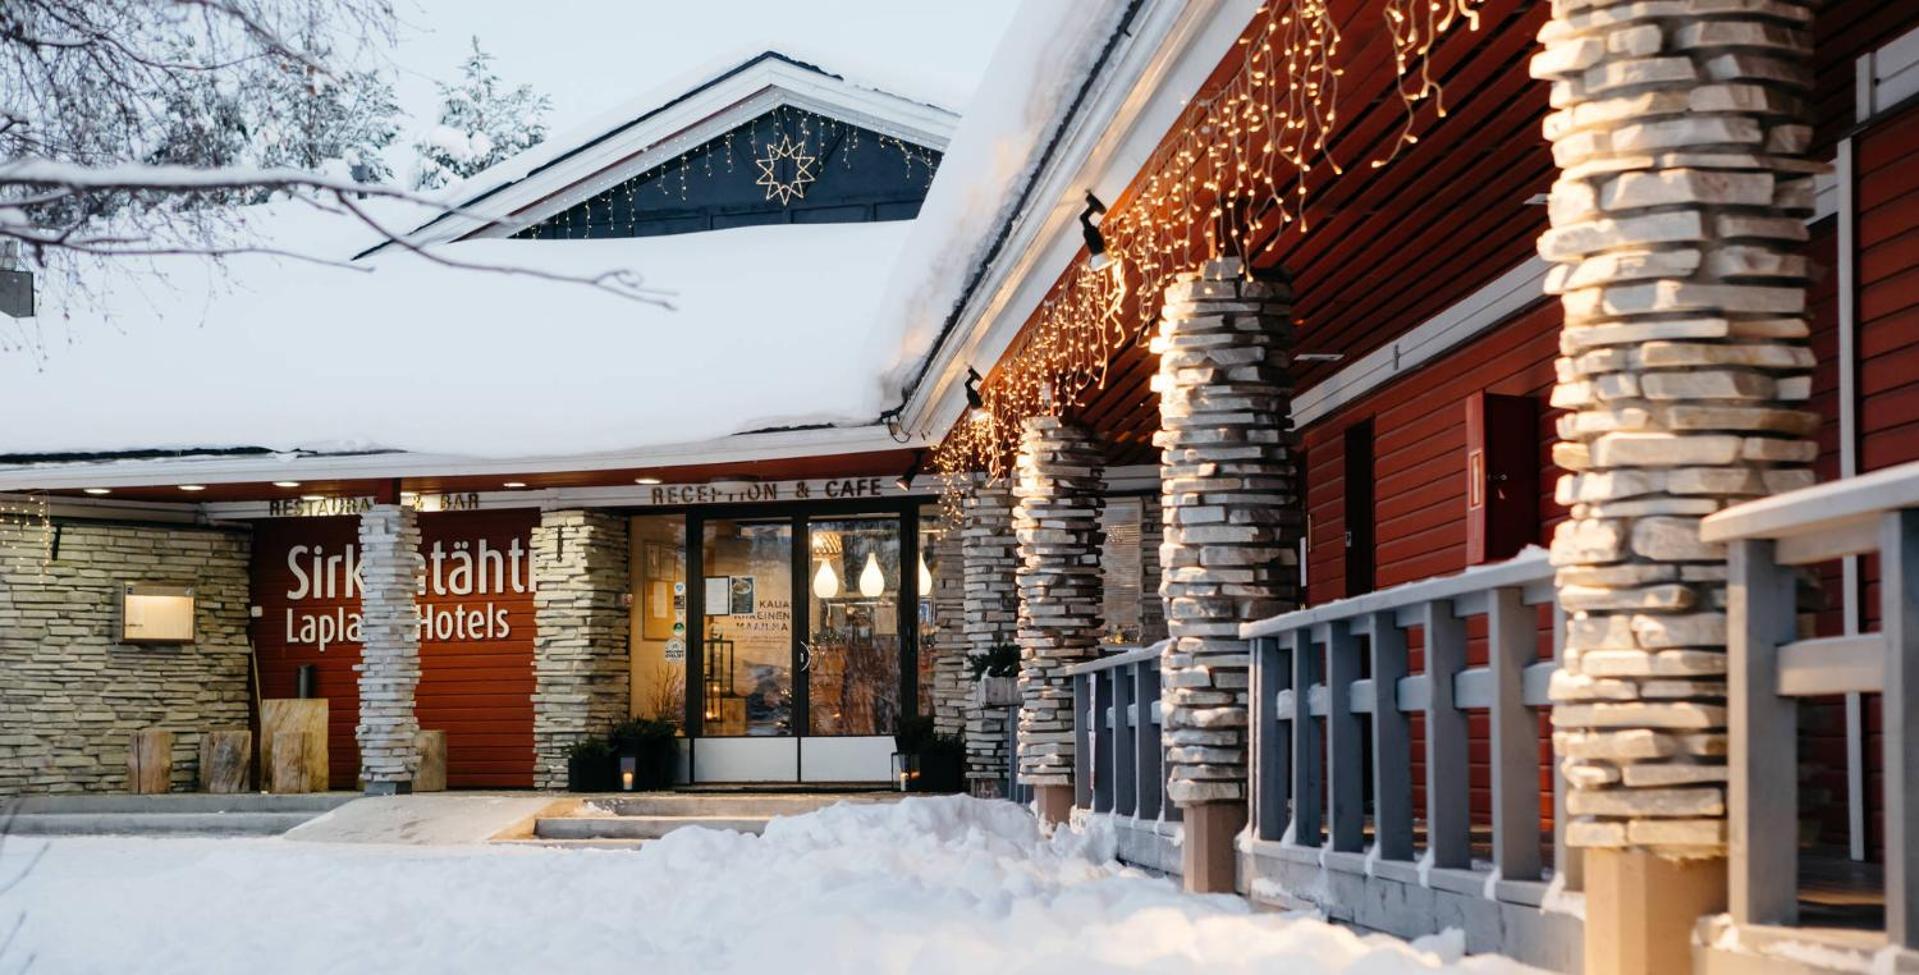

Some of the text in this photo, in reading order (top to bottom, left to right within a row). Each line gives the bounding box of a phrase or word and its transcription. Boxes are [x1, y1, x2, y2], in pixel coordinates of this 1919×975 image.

[269, 496, 370, 517] RESTAURA
[440, 492, 480, 510] BAR
[795, 481, 810, 499] &
[825, 478, 882, 497] CAFE
[286, 537, 537, 600] Sirktähti
[286, 602, 511, 652] Lapla Hotels
